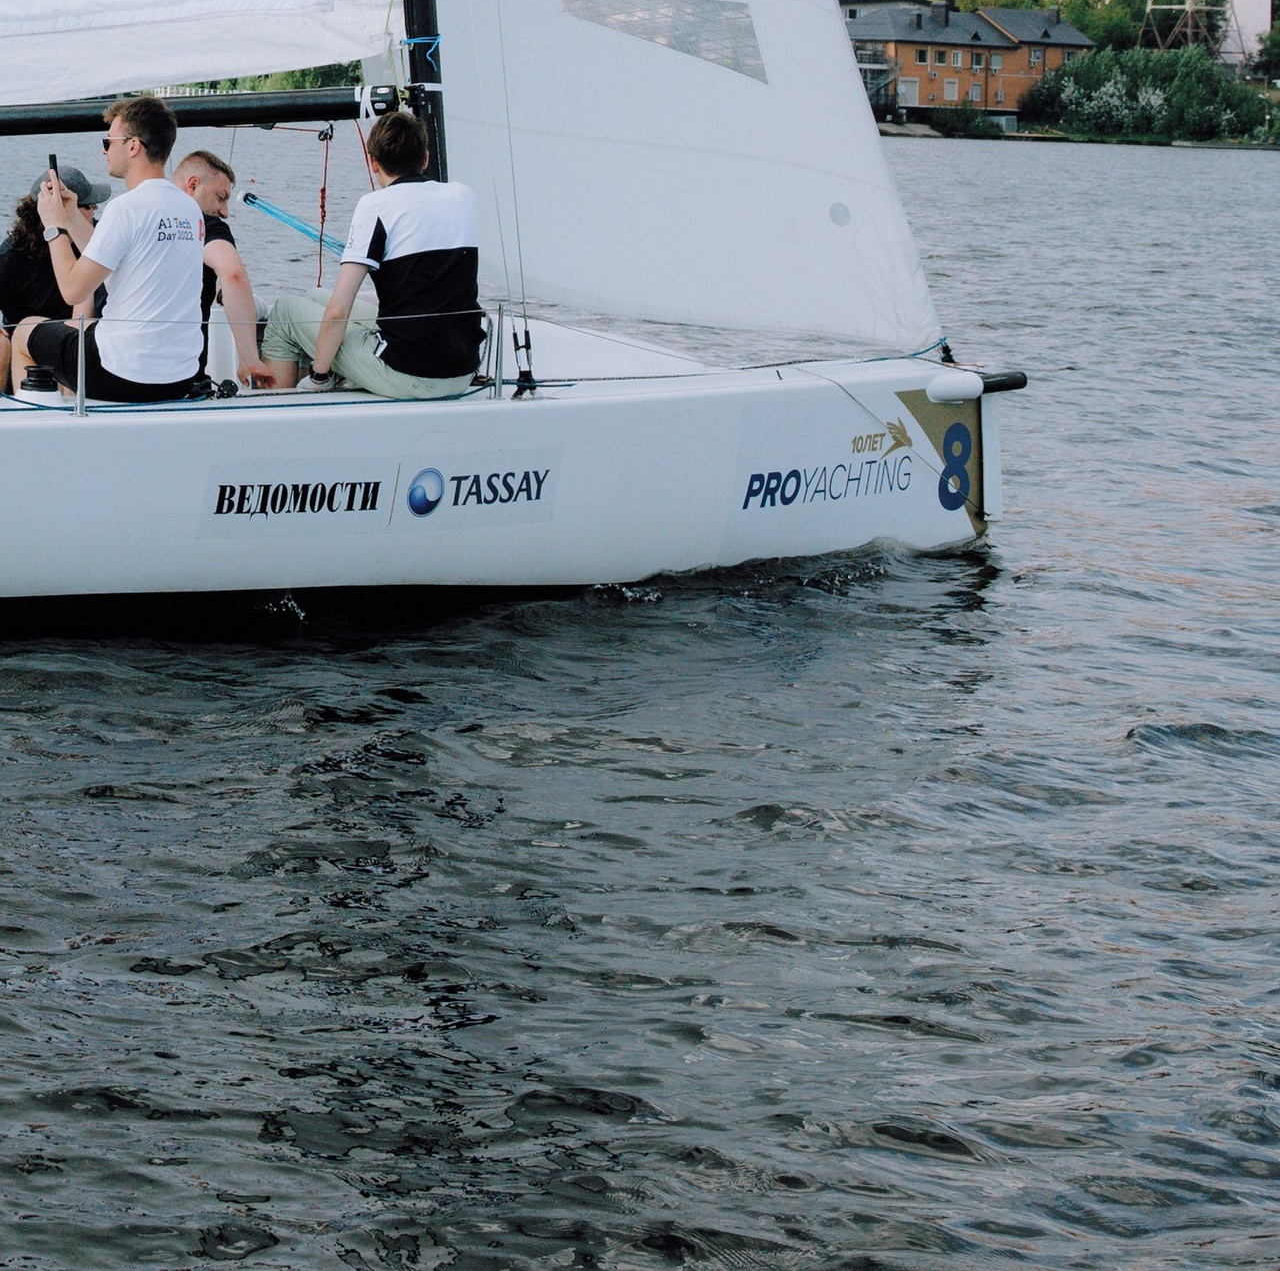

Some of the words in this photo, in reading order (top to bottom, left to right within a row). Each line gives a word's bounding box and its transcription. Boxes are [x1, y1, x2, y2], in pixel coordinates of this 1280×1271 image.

[157, 231, 177, 242] Day
[742, 455, 913, 510] PROYACHTING
[938, 422, 972, 511] 8
[213, 480, 382, 521] ВЕДОМОСТИ
[449, 468, 551, 507] TASSAY
